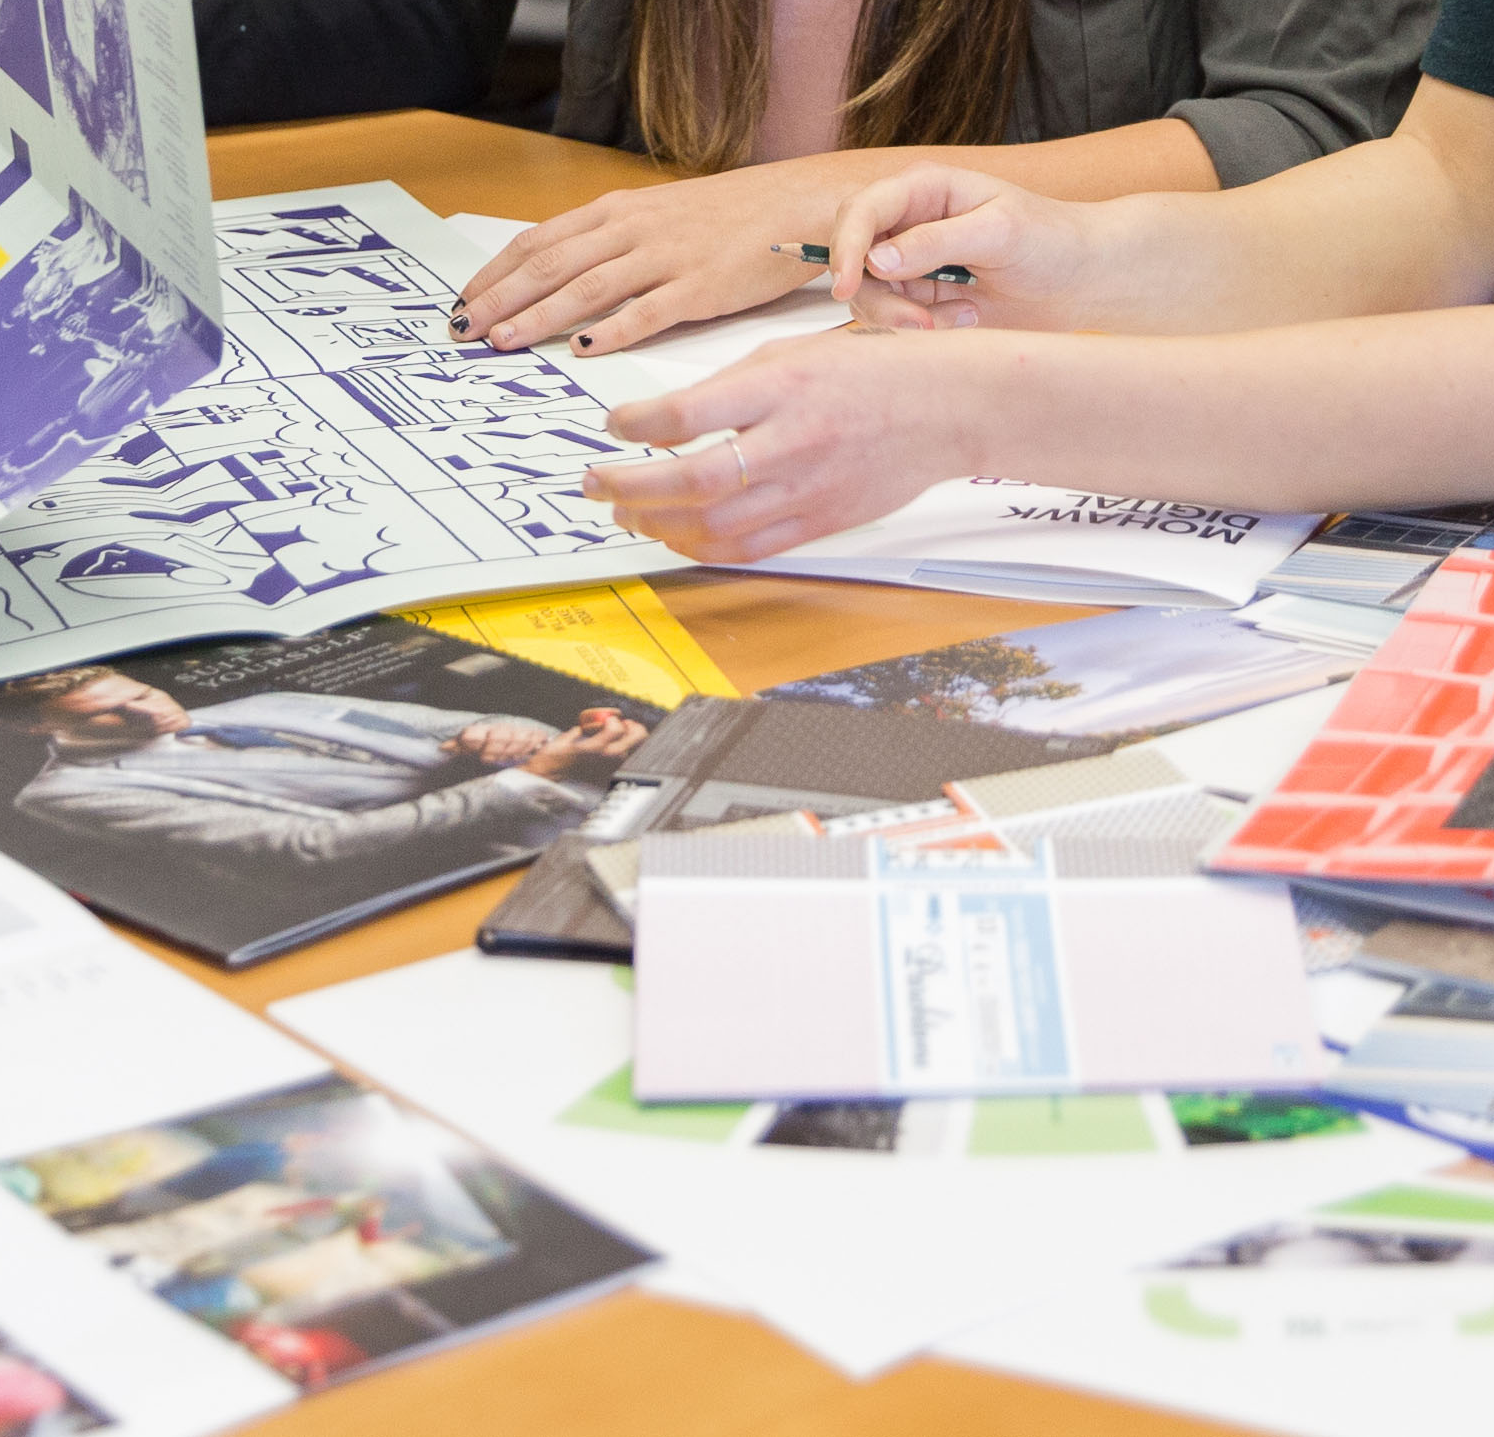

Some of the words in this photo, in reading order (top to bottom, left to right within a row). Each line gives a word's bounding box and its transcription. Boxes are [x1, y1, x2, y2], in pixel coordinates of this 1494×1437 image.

[997, 505, 1246, 545] MOHAWK
[1066, 494, 1261, 531] DIGITAL
[174, 654, 252, 684] SUIT
